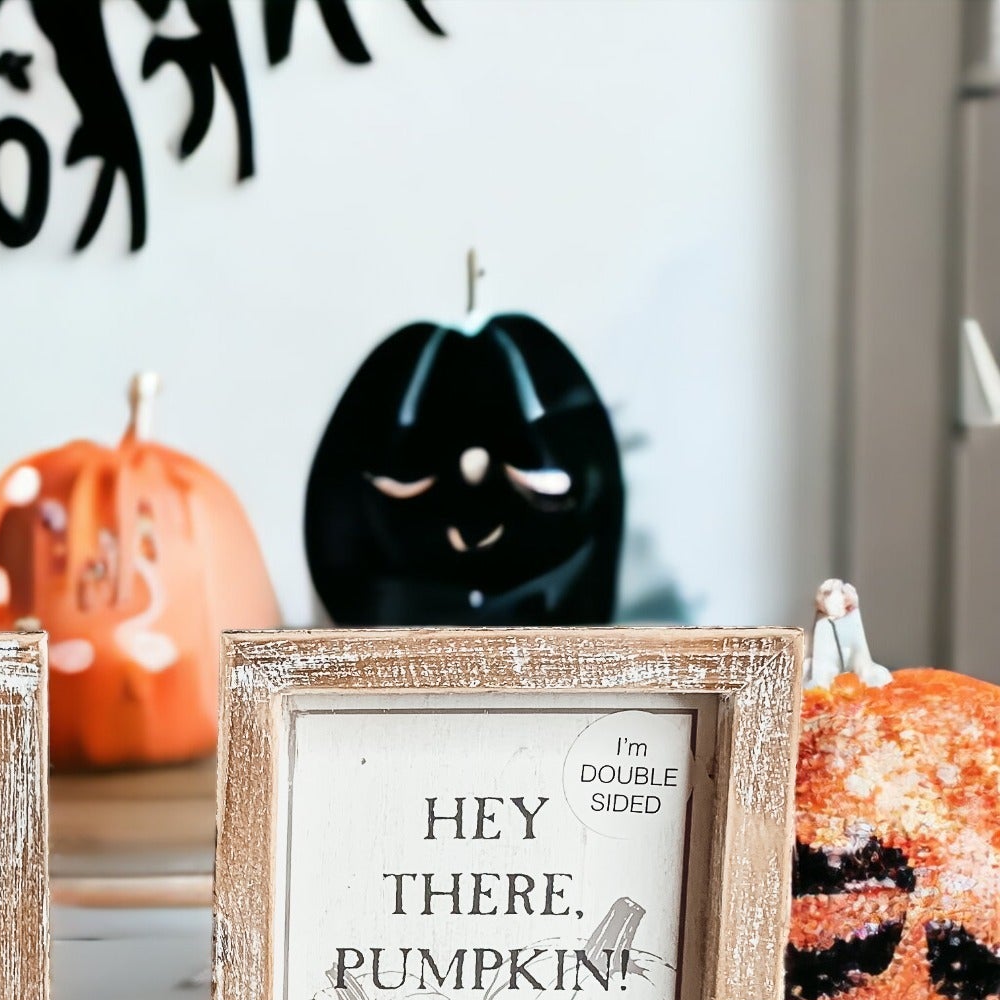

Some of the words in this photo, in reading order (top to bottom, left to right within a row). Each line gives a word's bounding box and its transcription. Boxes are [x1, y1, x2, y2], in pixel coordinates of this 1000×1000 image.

[616, 736, 648, 757] I'm
[579, 763, 679, 788] DOUBLE
[423, 797, 549, 841] HEY
[590, 793, 662, 815] SIDED
[382, 872, 584, 920] THERE,
[333, 947, 631, 993] PUMPKIN!
